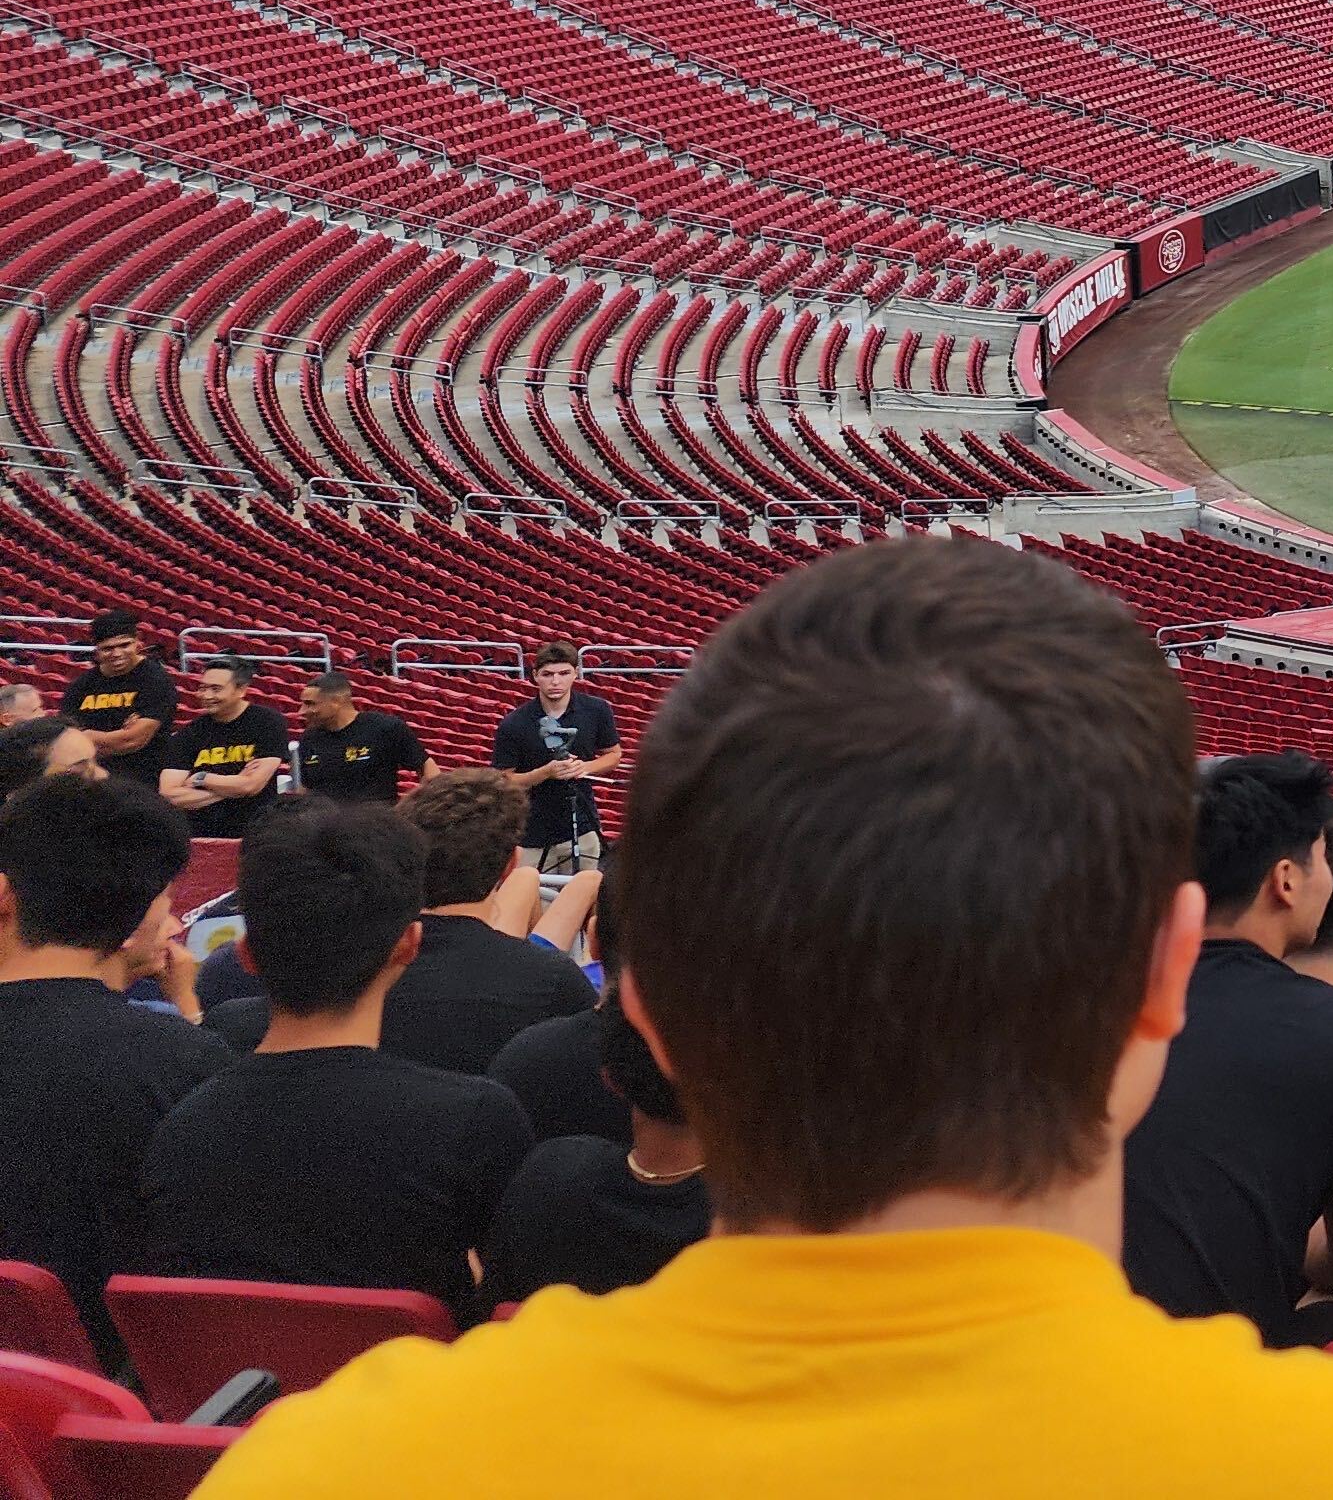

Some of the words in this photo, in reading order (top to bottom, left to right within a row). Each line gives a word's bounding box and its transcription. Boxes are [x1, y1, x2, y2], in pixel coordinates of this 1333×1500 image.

[1057, 276, 1097, 338] MUSCLE
[1094, 257, 1127, 306] MILK
[79, 691, 139, 711] ARMY
[193, 744, 256, 768] ARMY
